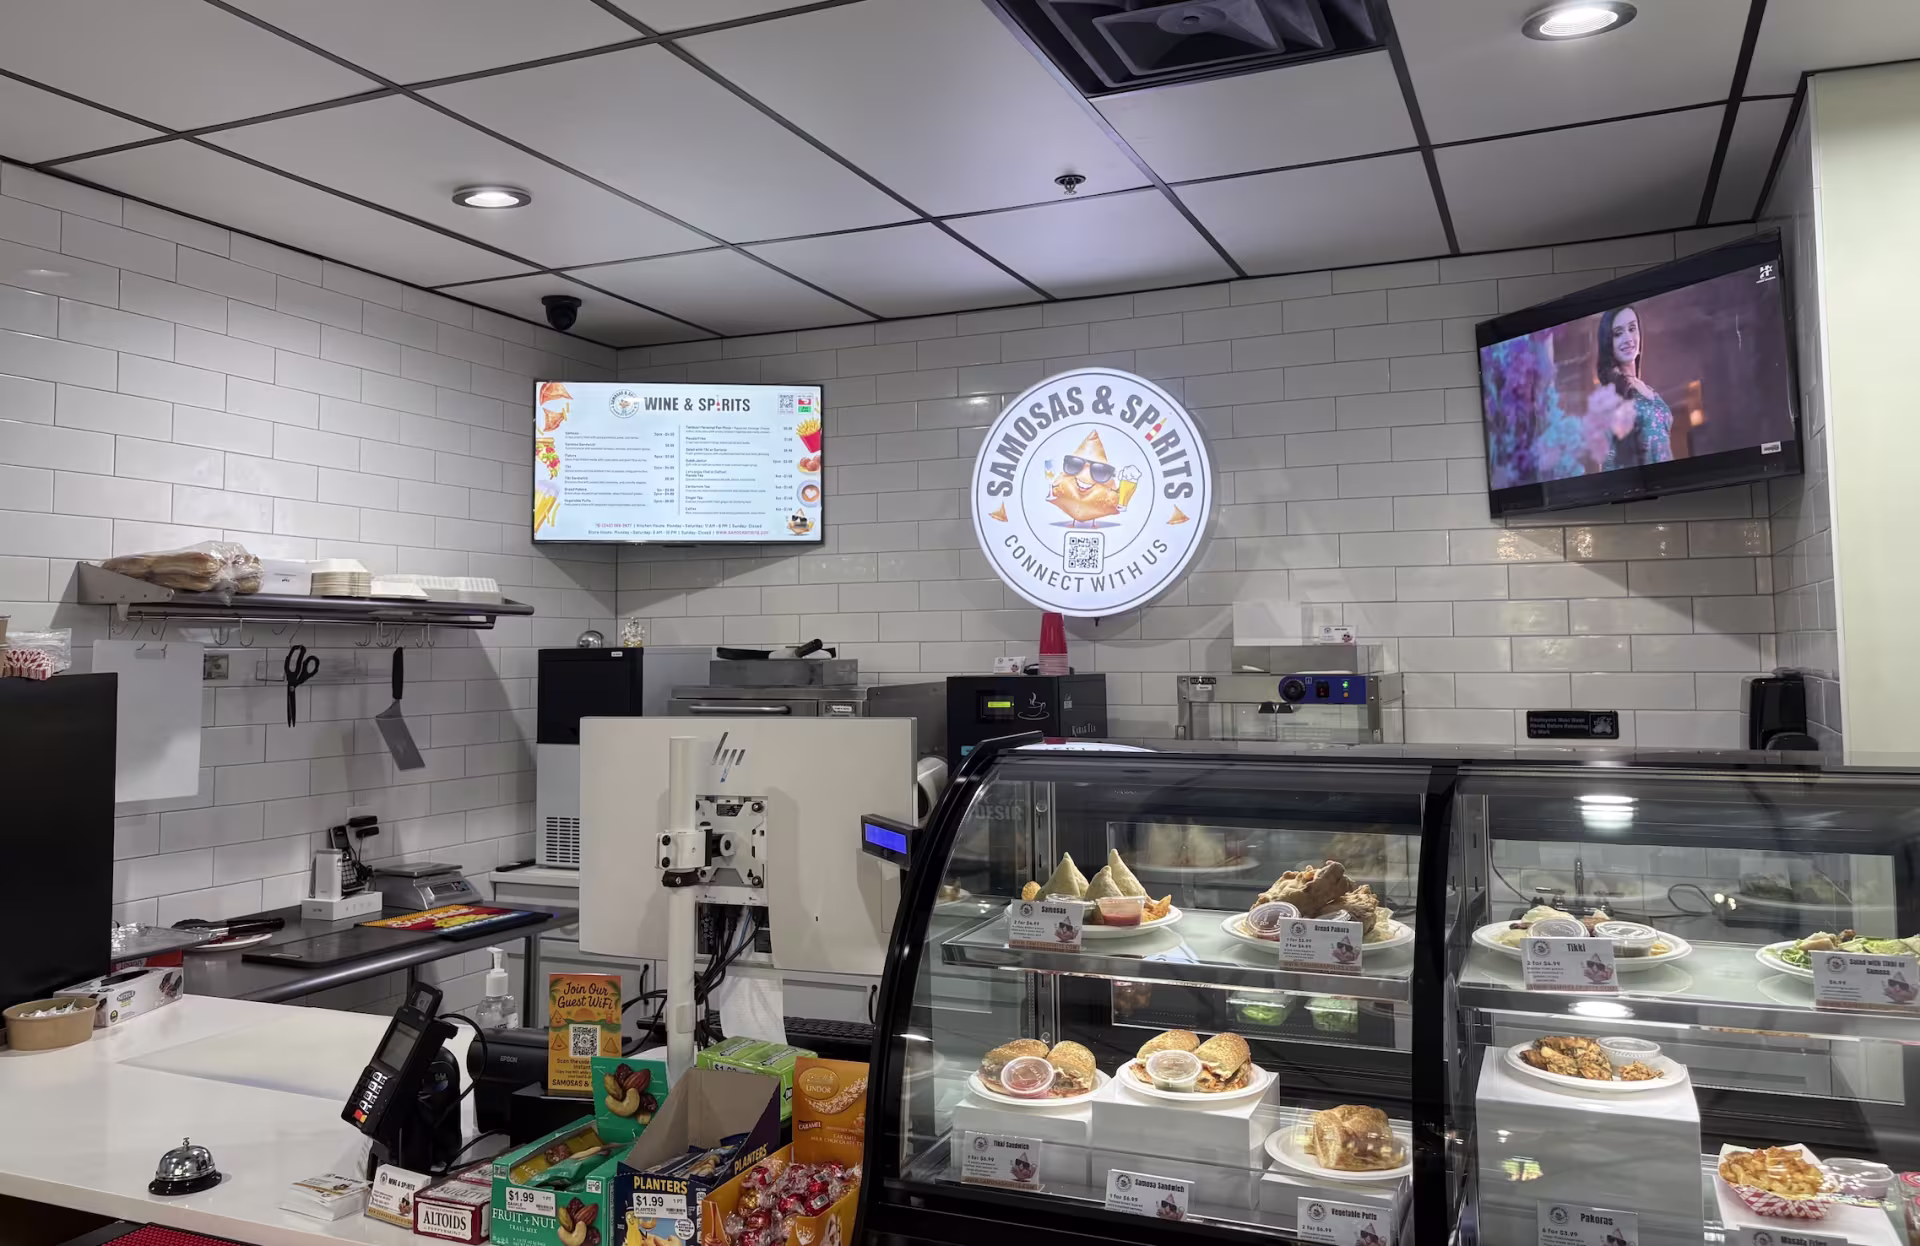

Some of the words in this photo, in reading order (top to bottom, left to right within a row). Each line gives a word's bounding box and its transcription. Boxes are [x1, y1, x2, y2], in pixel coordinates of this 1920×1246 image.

[643, 397, 678, 411] WINE
[684, 398, 693, 411] &
[986, 386, 1084, 498] SAMOSAS
[1091, 385, 1115, 415] &
[1004, 534, 1084, 593] CONNECT
[1090, 560, 1143, 592] WITH
[1142, 538, 1168, 565] US
[1041, 906, 1067, 914] Samosas
[563, 982, 586, 996] Join
[588, 982, 609, 996] Our
[557, 996, 587, 1009] Guest
[588, 996, 613, 1010] WiFi
[500, 1055, 518, 1063] EPSON
[552, 1079, 582, 1087] SAMOSAS
[798, 1122, 822, 1130] CARAMEL
[1006, 1141, 1030, 1150] Sandwich
[734, 1143, 767, 1175] PLANTERS
[633, 1176, 688, 1194] PLANTERS
[1135, 1178, 1156, 1188] Samosa
[1157, 1182, 1185, 1193] Sandwich
[508, 1190, 534, 1203] $1.99
[636, 1195, 664, 1207] $1.99
[492, 1208, 523, 1223] FRUIT
[531, 1216, 556, 1229] NUT
[1331, 1208, 1361, 1218] Vegetable
[1580, 1213, 1614, 1226] Pakoras
[423, 1210, 467, 1231] ALTOIDS
[509, 1222, 525, 1231] TRAIL
